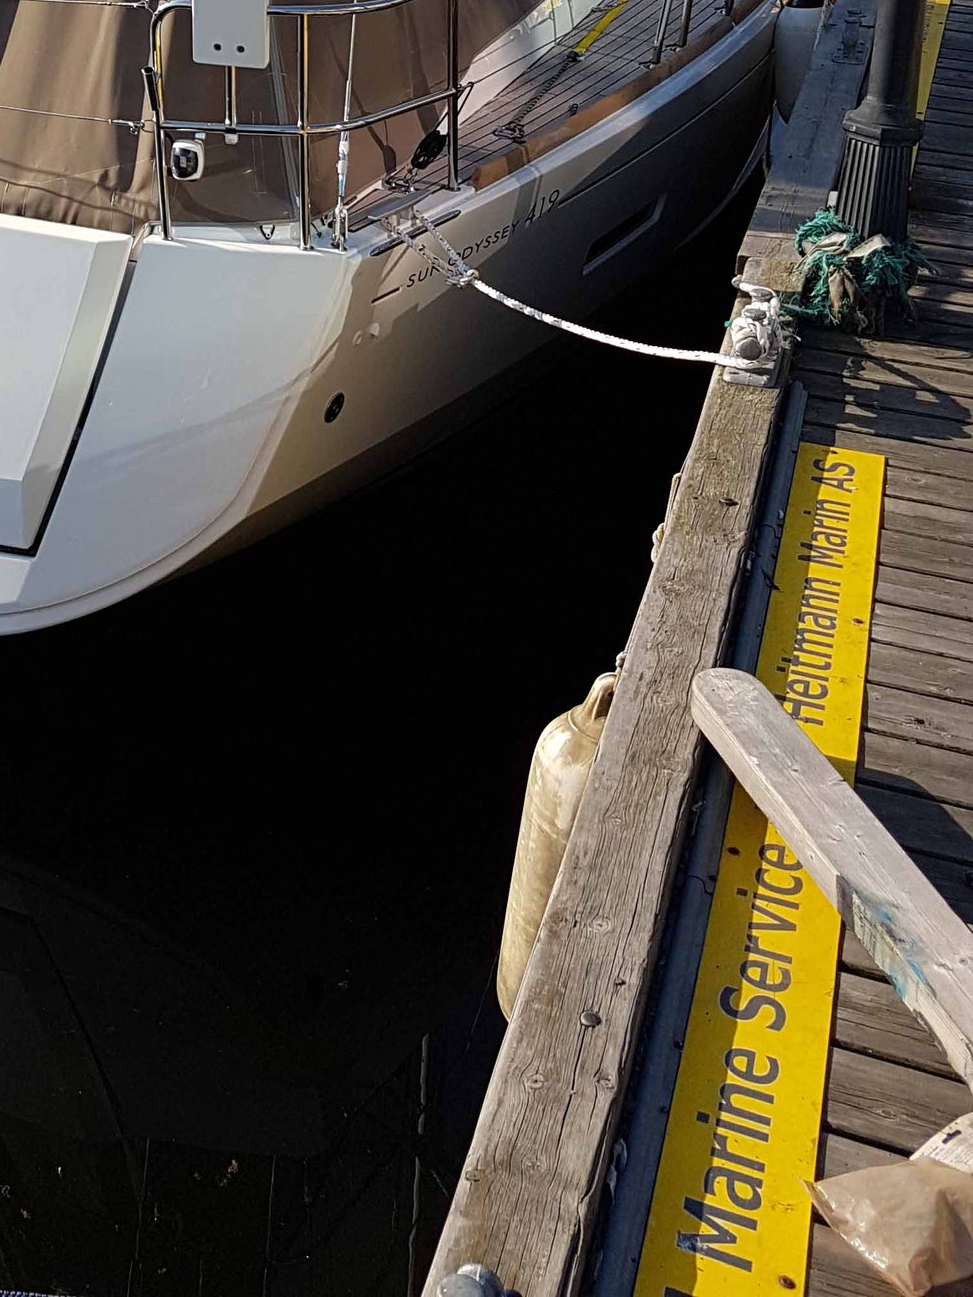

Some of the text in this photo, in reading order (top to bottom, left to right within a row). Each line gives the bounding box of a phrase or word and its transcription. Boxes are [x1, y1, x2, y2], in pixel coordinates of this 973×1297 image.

[448, 219, 521, 266] ODYSSEY
[525, 189, 560, 225] 419
[775, 458, 856, 726] Heitmann Marin AS
[676, 842, 804, 1273] Marine Service
